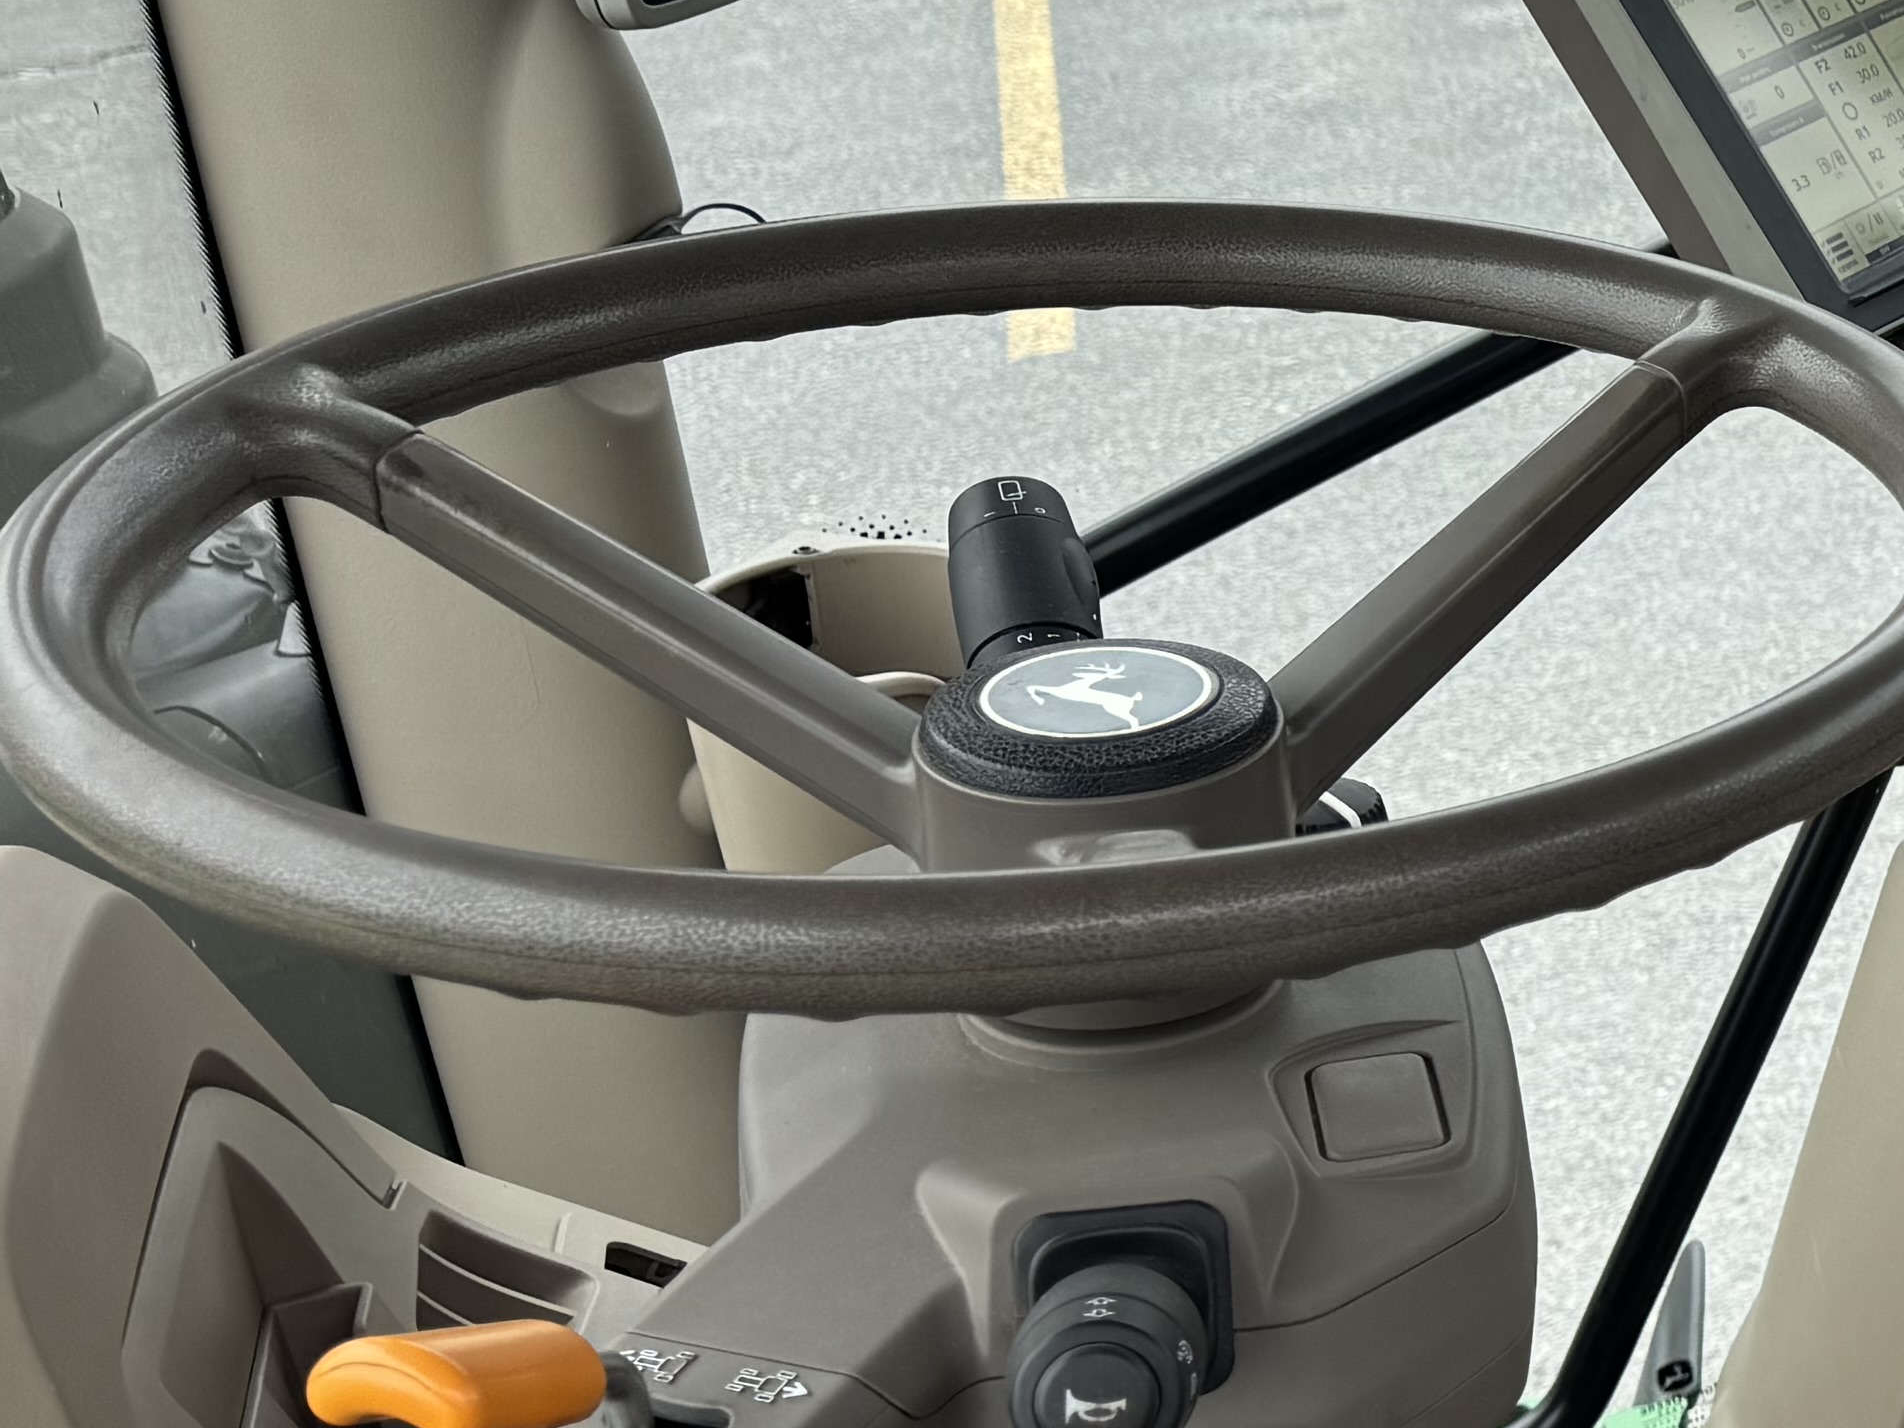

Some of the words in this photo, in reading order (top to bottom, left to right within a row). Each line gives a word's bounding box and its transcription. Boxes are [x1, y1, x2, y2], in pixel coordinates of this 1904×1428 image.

[1815, 57, 1832, 74] F2
[1843, 41, 1867, 61] 42.0
[1828, 80, 1845, 96] F1
[1856, 63, 1880, 84] 30.0
[1855, 124, 1872, 141] R1
[1867, 147, 1886, 164] R2
[1791, 173, 1811, 192] 3.3
